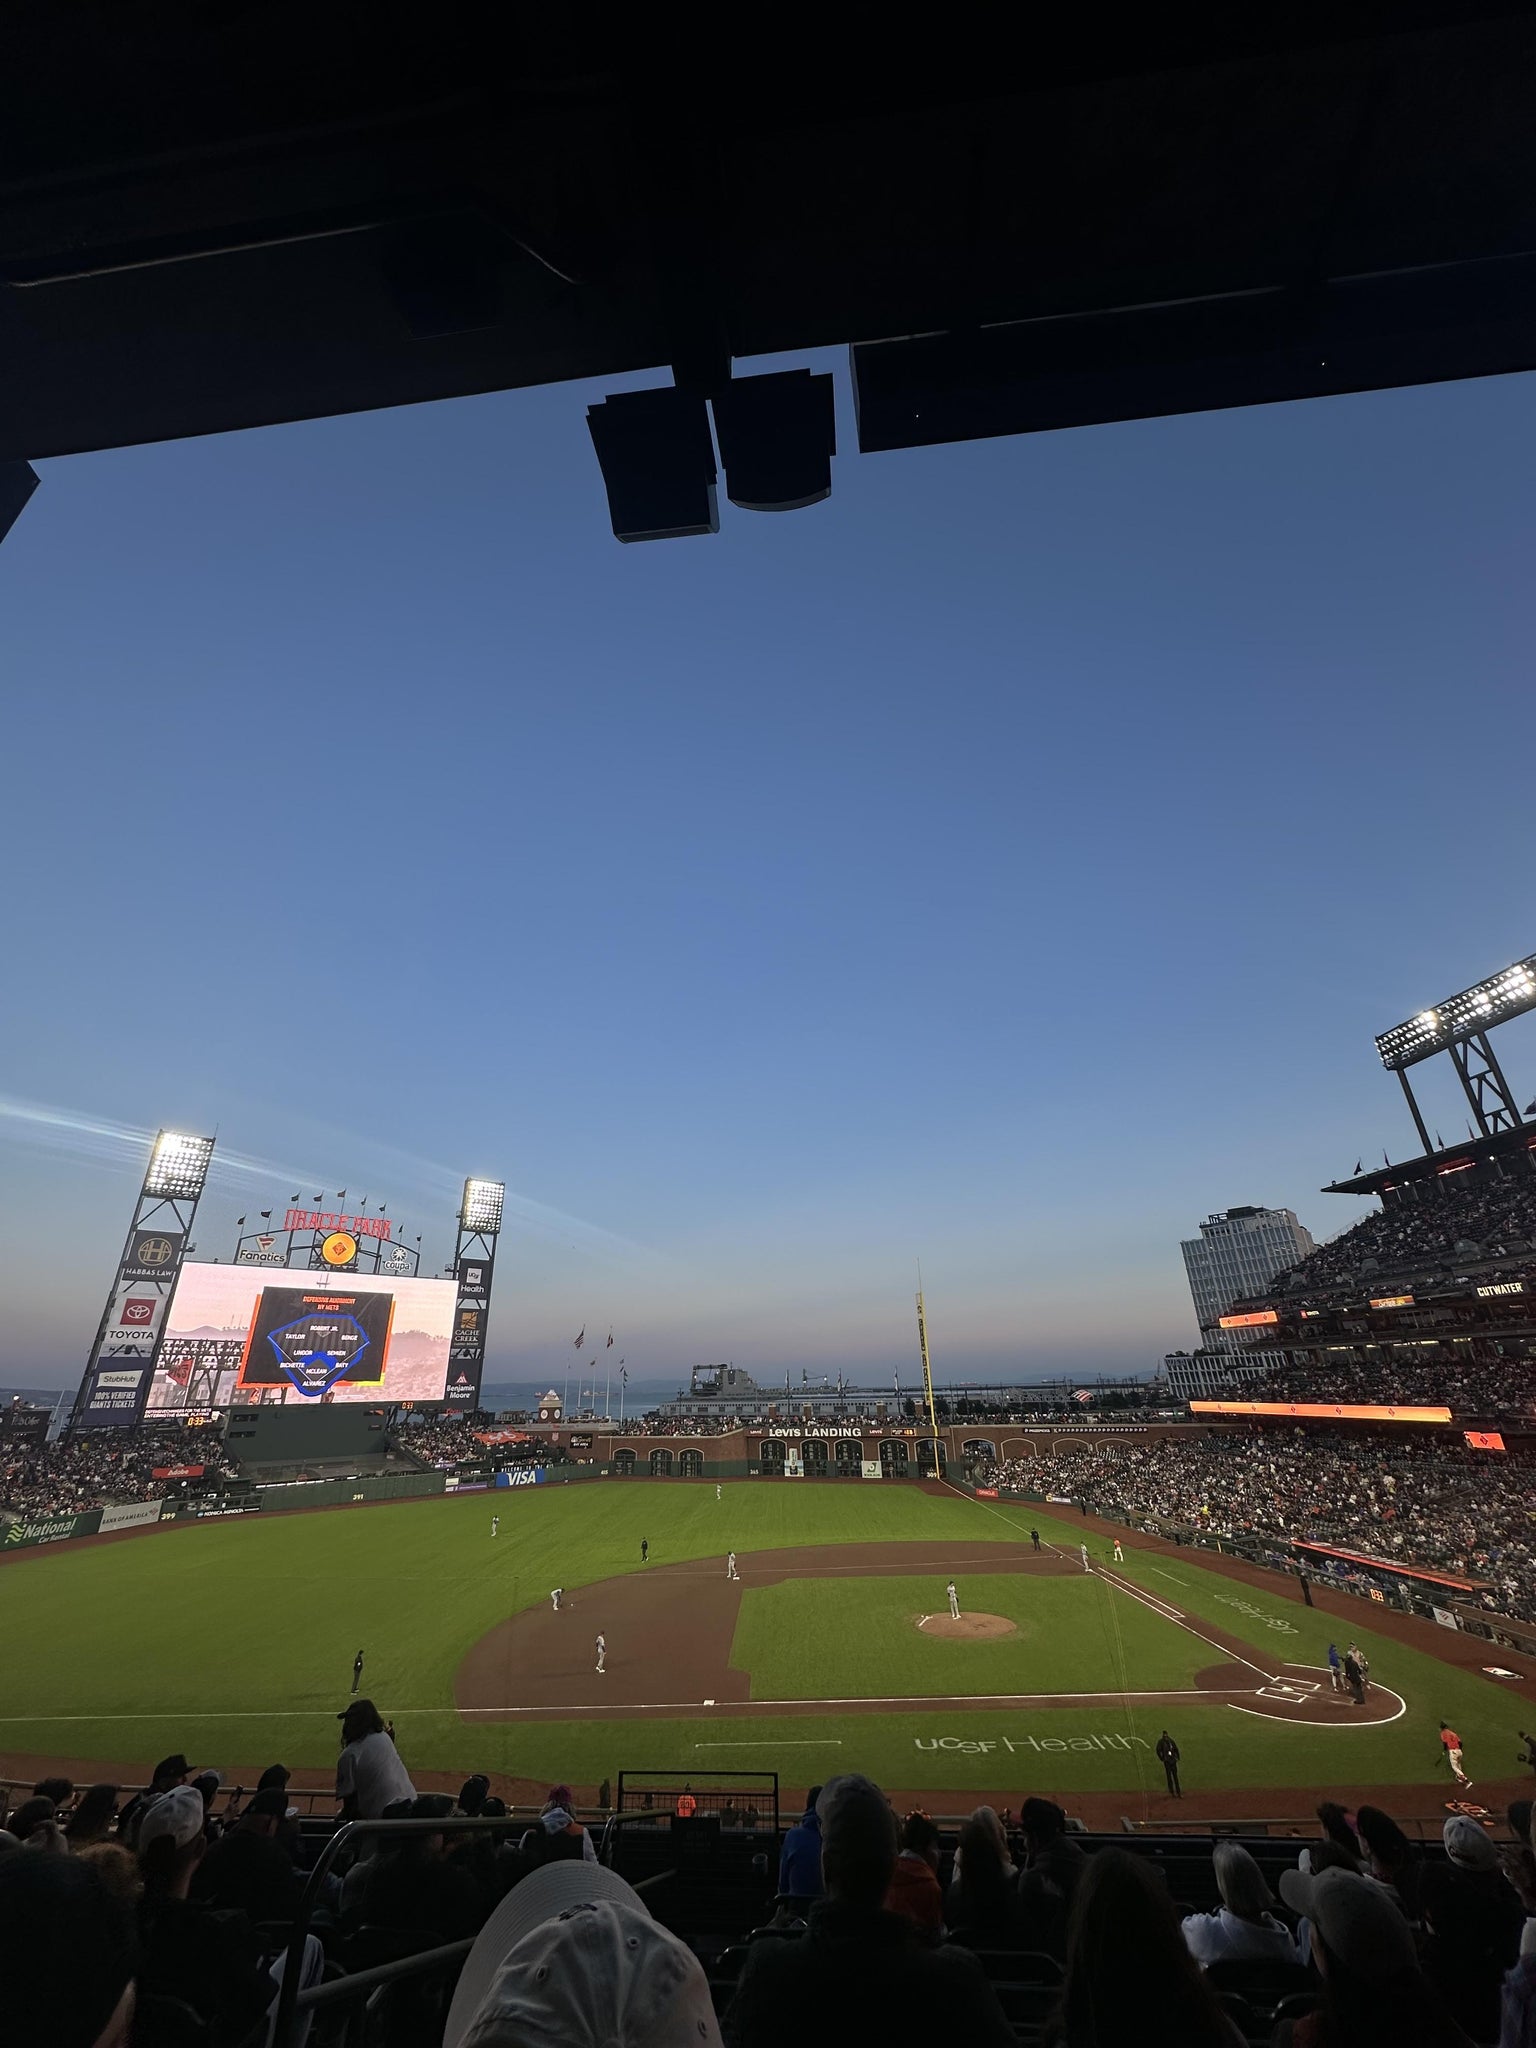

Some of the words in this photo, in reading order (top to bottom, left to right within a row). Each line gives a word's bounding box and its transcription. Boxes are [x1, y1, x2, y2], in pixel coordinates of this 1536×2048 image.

[284, 1209, 349, 1232] ORACLE
[353, 1216, 392, 1240] PARK
[239, 1250, 285, 1263] Fanatics
[385, 1261, 410, 1272] coupa
[126, 1268, 156, 1276] HABBAS
[156, 1269, 172, 1277] LAW
[460, 1285, 485, 1293] Health
[1477, 1282, 1523, 1297] CUTWATER
[109, 1330, 154, 1339] TOYOTA
[104, 1375, 136, 1383] StubHub
[446, 1385, 475, 1393] Benjamin
[95, 1391, 110, 1400] 100%
[110, 1391, 136, 1400] VERIFIED
[450, 1391, 471, 1399] Moore
[90, 1400, 111, 1409] GIANTS
[111, 1400, 136, 1408] TICKETS
[187, 1416, 204, 1426] 0:33
[805, 1428, 861, 1437] LANDING
[506, 1470, 537, 1486] VISA
[161, 1512, 176, 1520] 399
[23, 1517, 77, 1539] National
[38, 1535, 50, 1544] Car
[50, 1532, 70, 1542] Rental
[914, 1736, 997, 1754] UCSF
[1001, 1734, 1151, 1753] Health
